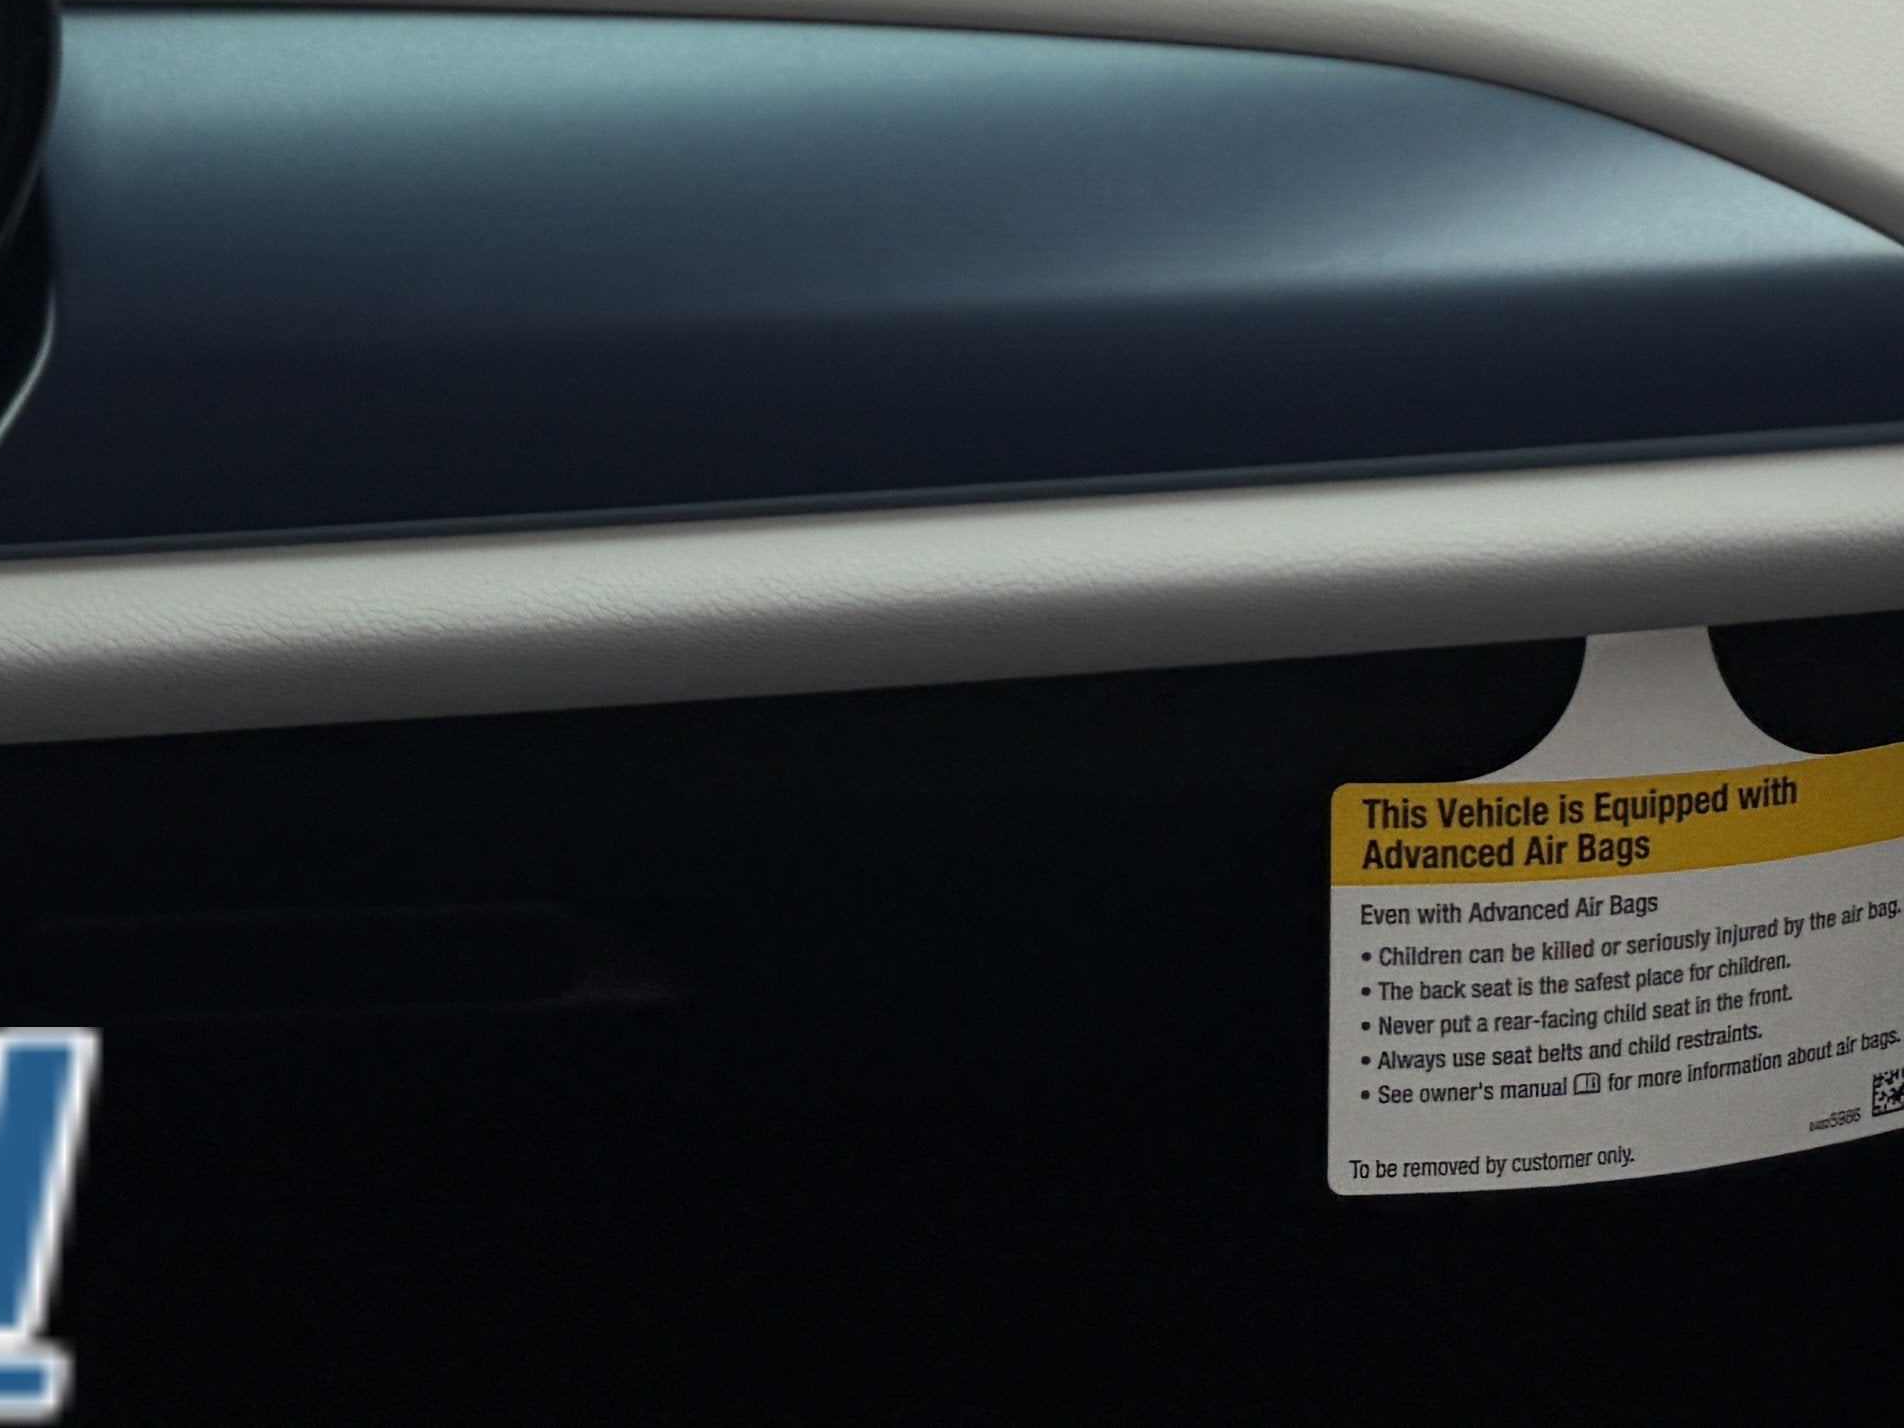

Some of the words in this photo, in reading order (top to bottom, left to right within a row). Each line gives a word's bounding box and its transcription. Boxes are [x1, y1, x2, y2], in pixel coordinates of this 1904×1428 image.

[1362, 797, 1428, 830] This
[1437, 795, 1549, 829] Vehicle
[1559, 794, 1585, 825] is
[1594, 782, 1728, 827] Equipped
[1737, 776, 1798, 811] with
[1362, 836, 1514, 870] Advanced
[1524, 834, 1568, 866] Air
[1578, 832, 1650, 868] Bags
[1361, 903, 1410, 926] Even
[1417, 902, 1461, 924] with
[1469, 898, 1569, 924] Advanced
[1575, 897, 1604, 918] Air
[1610, 893, 1658, 918] Bags
[1379, 945, 1463, 968] Children
[1469, 947, 1504, 964] can
[1511, 942, 1535, 963] be
[1541, 939, 1594, 961] killed
[1601, 941, 1622, 958] or
[1626, 929, 1711, 955] seriously
[1716, 918, 1779, 950] injured
[1784, 917, 1805, 938] by
[1809, 911, 1836, 931] the
[1841, 904, 1864, 925] air
[1867, 899, 1902, 920] bag.
[1378, 981, 1413, 1001] The
[1420, 980, 1466, 1001] back
[1472, 978, 1511, 999] seat
[1517, 976, 1534, 996] is
[1539, 975, 1569, 995] the
[1574, 971, 1631, 993] safest
[1636, 967, 1684, 992] place
[1689, 963, 1714, 983] for
[1718, 954, 1792, 979] children.
[1379, 1015, 1435, 1036] Never
[1440, 1015, 1472, 1038] put
[1476, 1016, 1489, 1032] a
[1494, 1008, 1598, 1031] rear-facing
[1603, 1002, 1647, 1025] child
[1652, 998, 1691, 1020] seat
[1696, 994, 1711, 1015] in
[1716, 991, 1744, 1012] the
[1748, 984, 1793, 1008] front.
[1377, 1050, 1446, 1072] Always
[1452, 1050, 1485, 1067] use
[1492, 1045, 1533, 1065] seat
[1538, 1042, 1583, 1064] belts
[1588, 1038, 1623, 1060] and
[1628, 1033, 1671, 1056] child
[1676, 1023, 1763, 1051] restraints.
[1378, 1084, 1413, 1104] See
[1419, 1082, 1494, 1103] owner's
[1499, 1076, 1568, 1100] manual
[1607, 1072, 1632, 1092] for
[1637, 1068, 1683, 1089] more
[1687, 1053, 1783, 1083] information
[1787, 1040, 1833, 1067] about
[1836, 1037, 1855, 1057] air
[1860, 1029, 1901, 1053] bags.
[1349, 1159, 1370, 1180] To
[1376, 1158, 1398, 1179] be
[1402, 1155, 1480, 1179] removed
[1485, 1155, 1508, 1178] by
[1511, 1150, 1593, 1173] customer
[1597, 1144, 1635, 1168] only.
